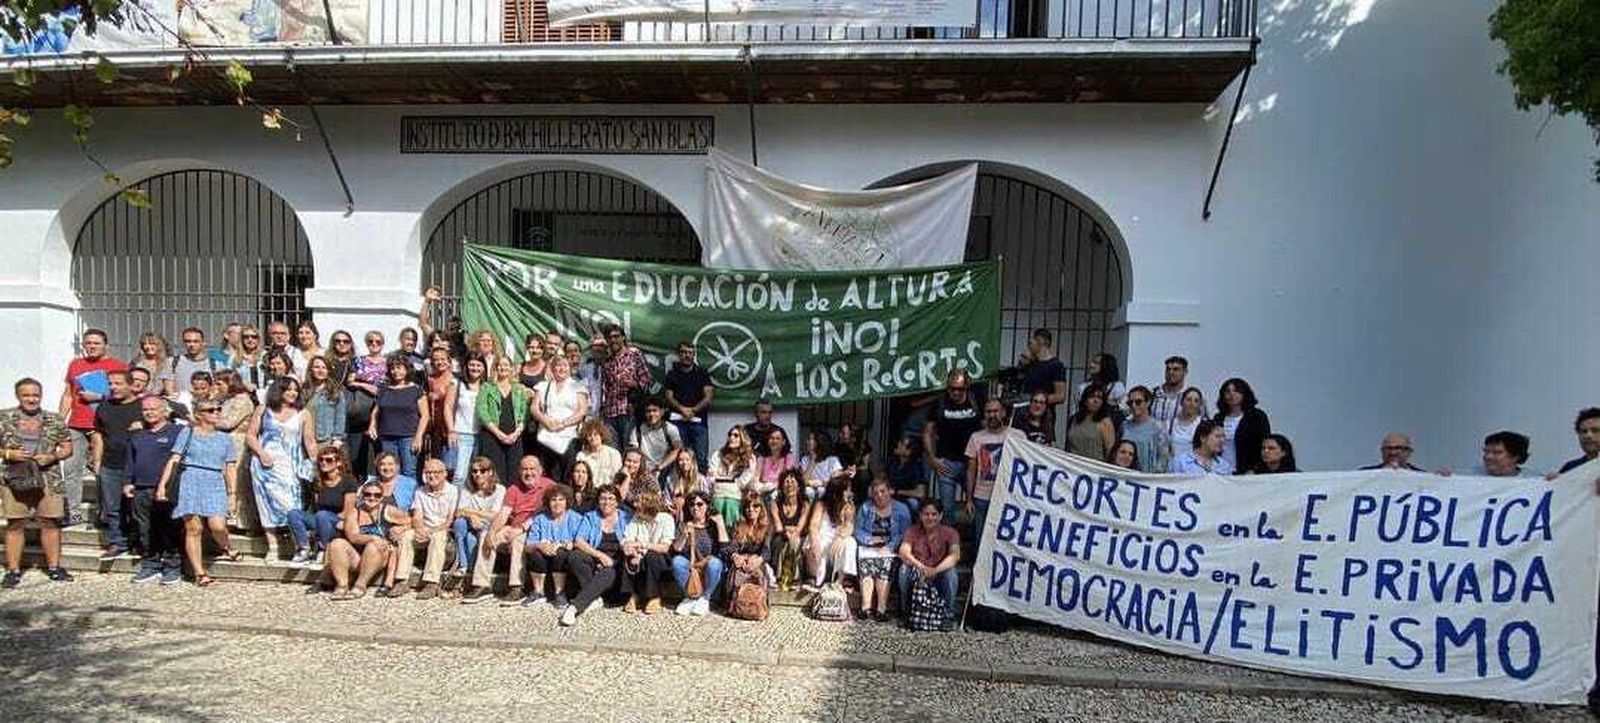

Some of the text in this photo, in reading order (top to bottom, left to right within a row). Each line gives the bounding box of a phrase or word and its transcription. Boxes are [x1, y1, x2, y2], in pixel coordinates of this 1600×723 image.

[631, 118, 662, 148] SAN
[668, 118, 709, 148] BLAS
[571, 276, 607, 295] una
[804, 284, 830, 312] de
[839, 269, 975, 310] ALTURA
[760, 361, 783, 398] A
[796, 360, 848, 399] LOS
[1008, 457, 1201, 531] RECORTES
[1218, 522, 1249, 539] en
[1256, 511, 1284, 540] la
[1302, 493, 1336, 542] E.
[1211, 569, 1240, 586] en
[1250, 561, 1278, 589] la
[1295, 554, 1327, 595] E.
